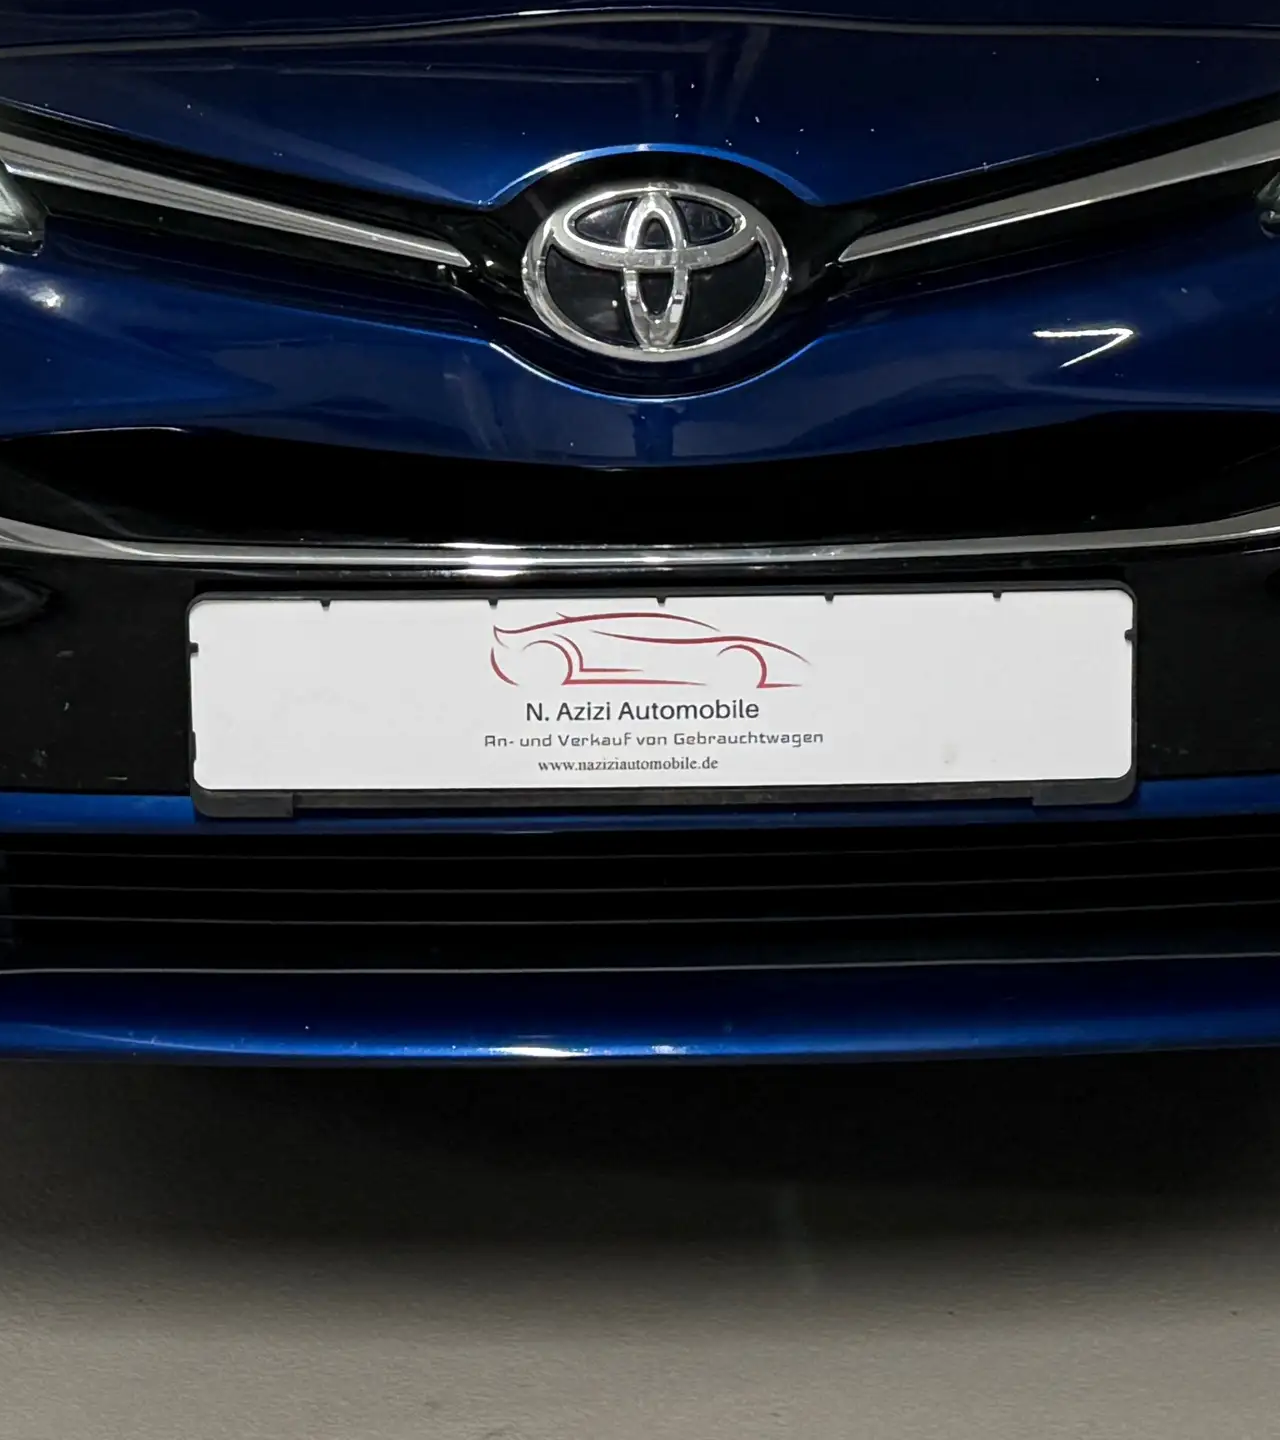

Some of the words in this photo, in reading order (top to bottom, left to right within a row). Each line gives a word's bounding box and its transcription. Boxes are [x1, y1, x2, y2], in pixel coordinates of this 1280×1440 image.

[526, 702, 550, 722] N.
[556, 701, 611, 722] Azizi
[617, 698, 760, 721] Automobile
[484, 734, 514, 748] An-
[519, 733, 552, 748] und
[557, 731, 631, 747] Verkauf
[636, 736, 667, 746] von
[673, 731, 824, 748] Gebrauchtwagen
[538, 756, 719, 771] www.naziziautomobile.de
